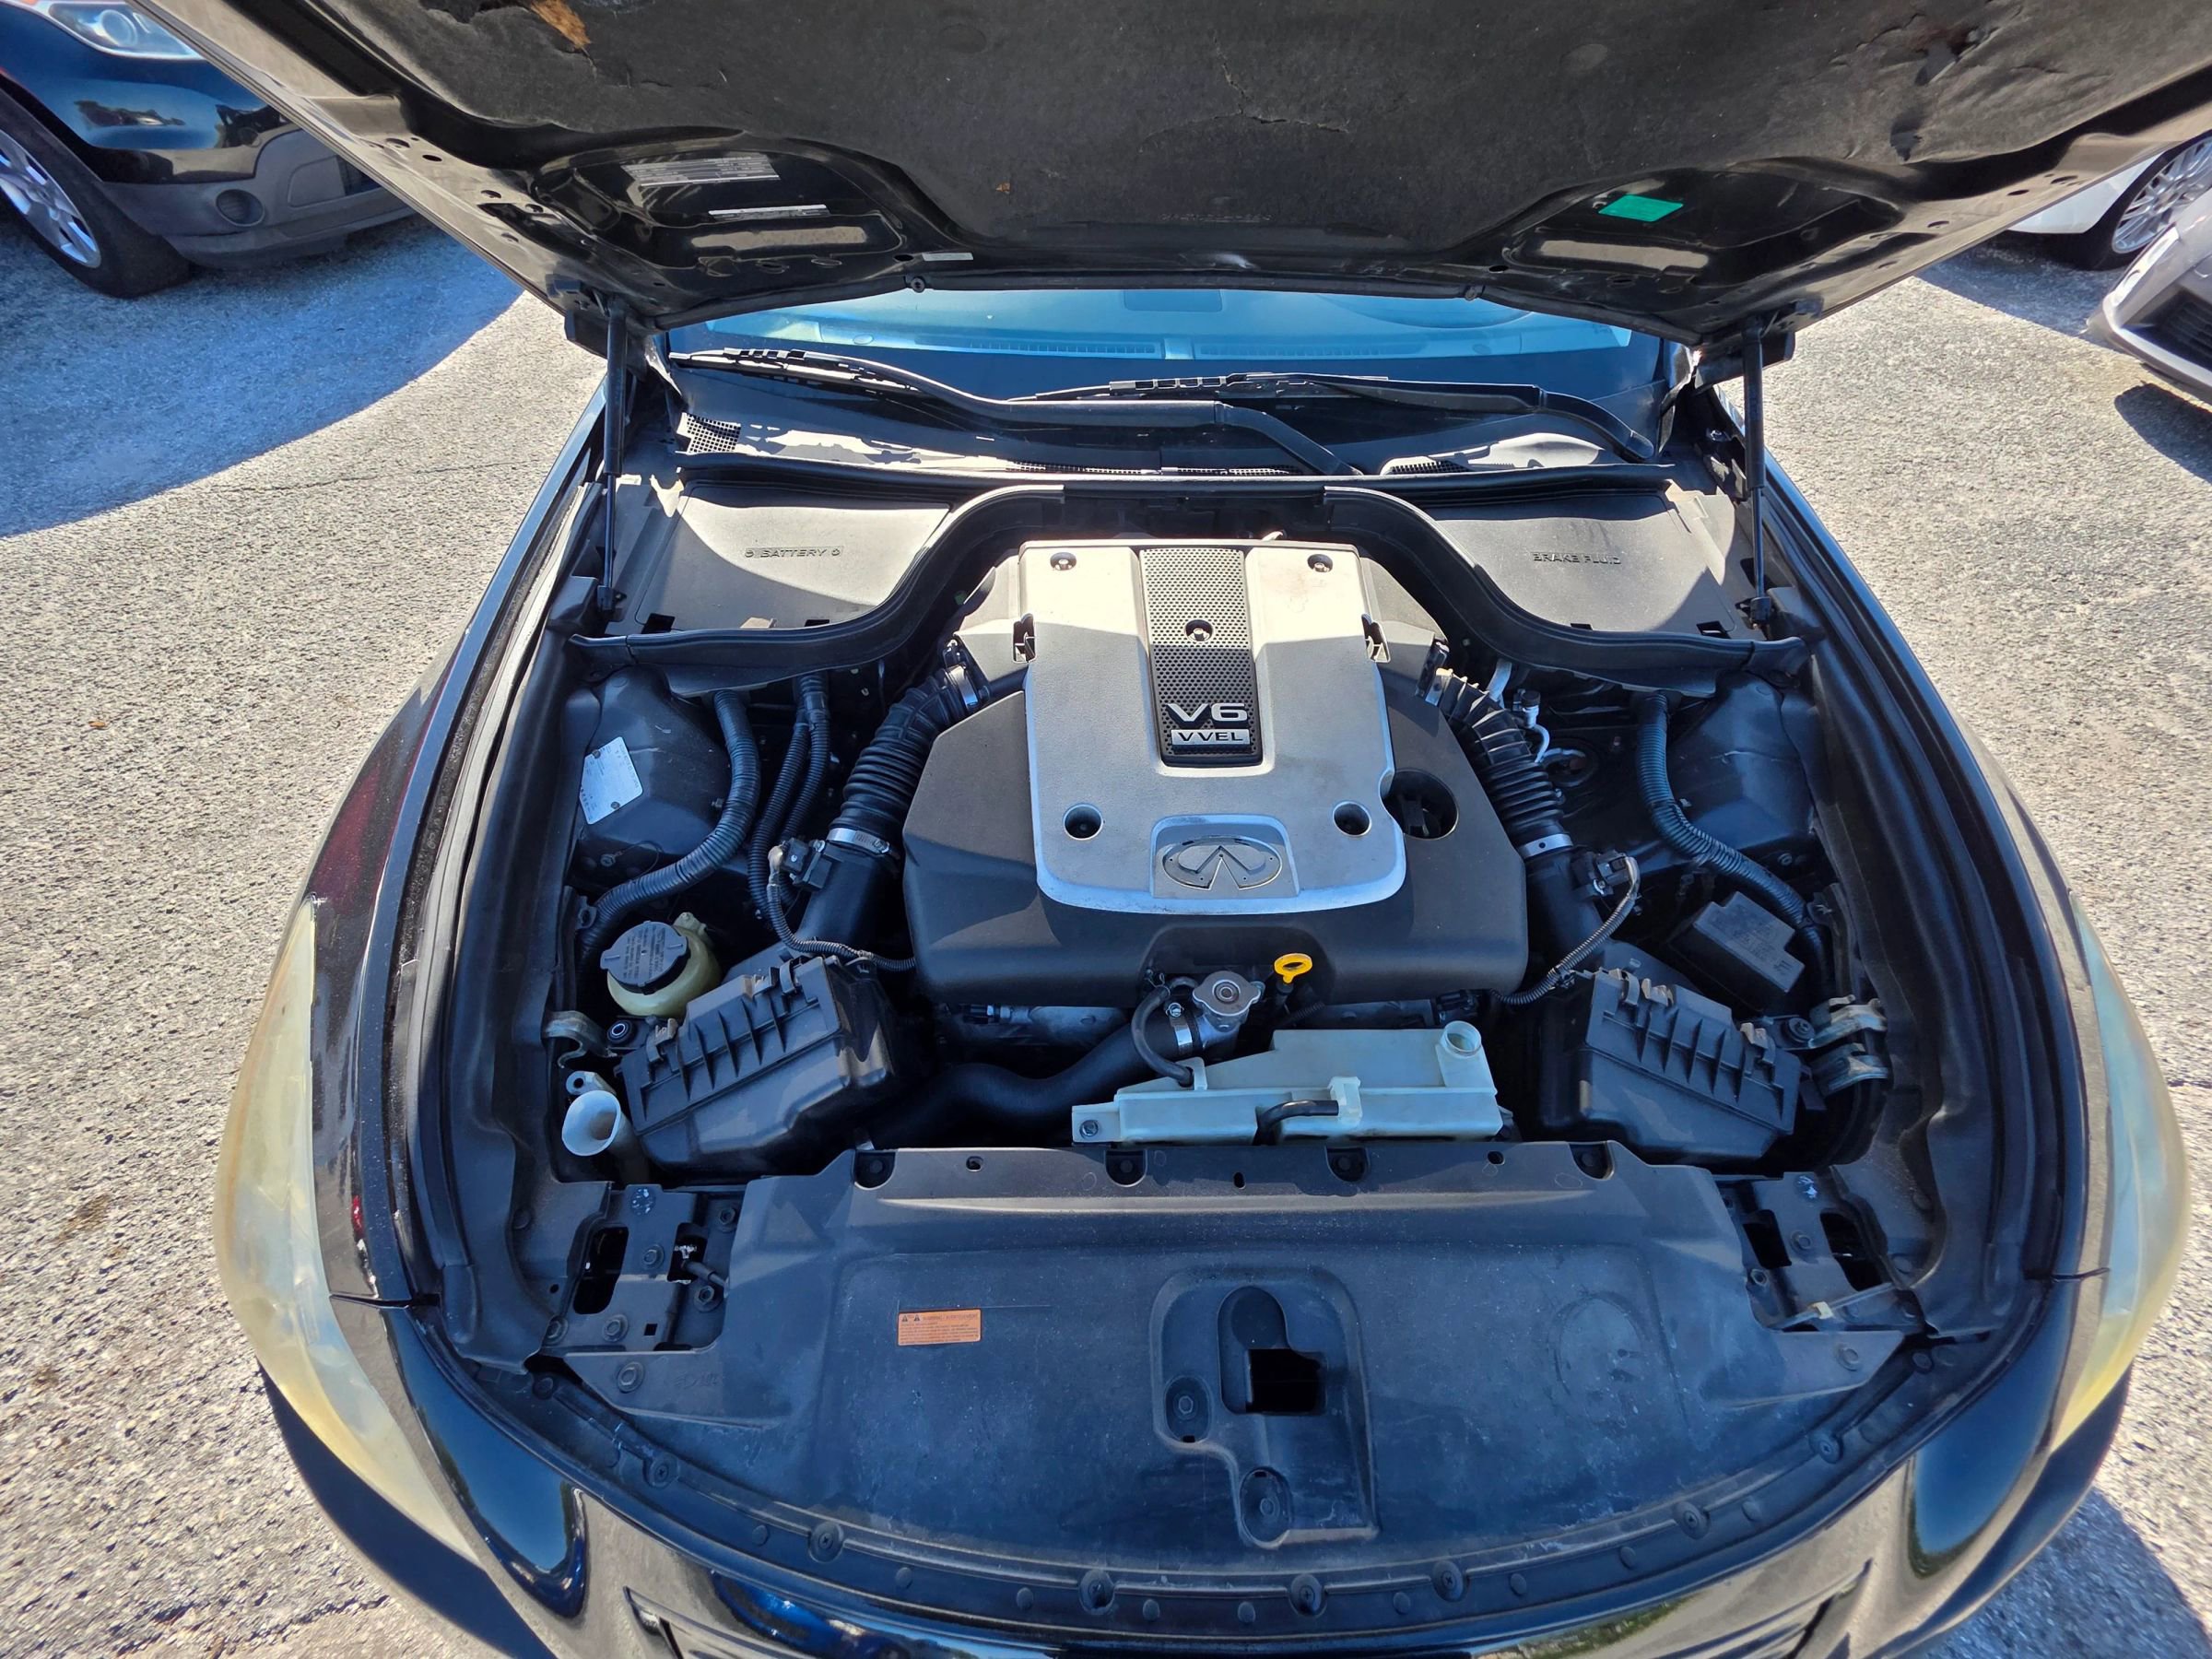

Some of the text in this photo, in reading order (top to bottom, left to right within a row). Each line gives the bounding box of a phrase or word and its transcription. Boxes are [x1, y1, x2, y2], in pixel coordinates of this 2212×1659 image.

[759, 548, 828, 559] BATTERY
[1532, 552, 1581, 564] BRAKE
[1165, 702, 1248, 723] V6
[1177, 732, 1243, 742] VVEL
